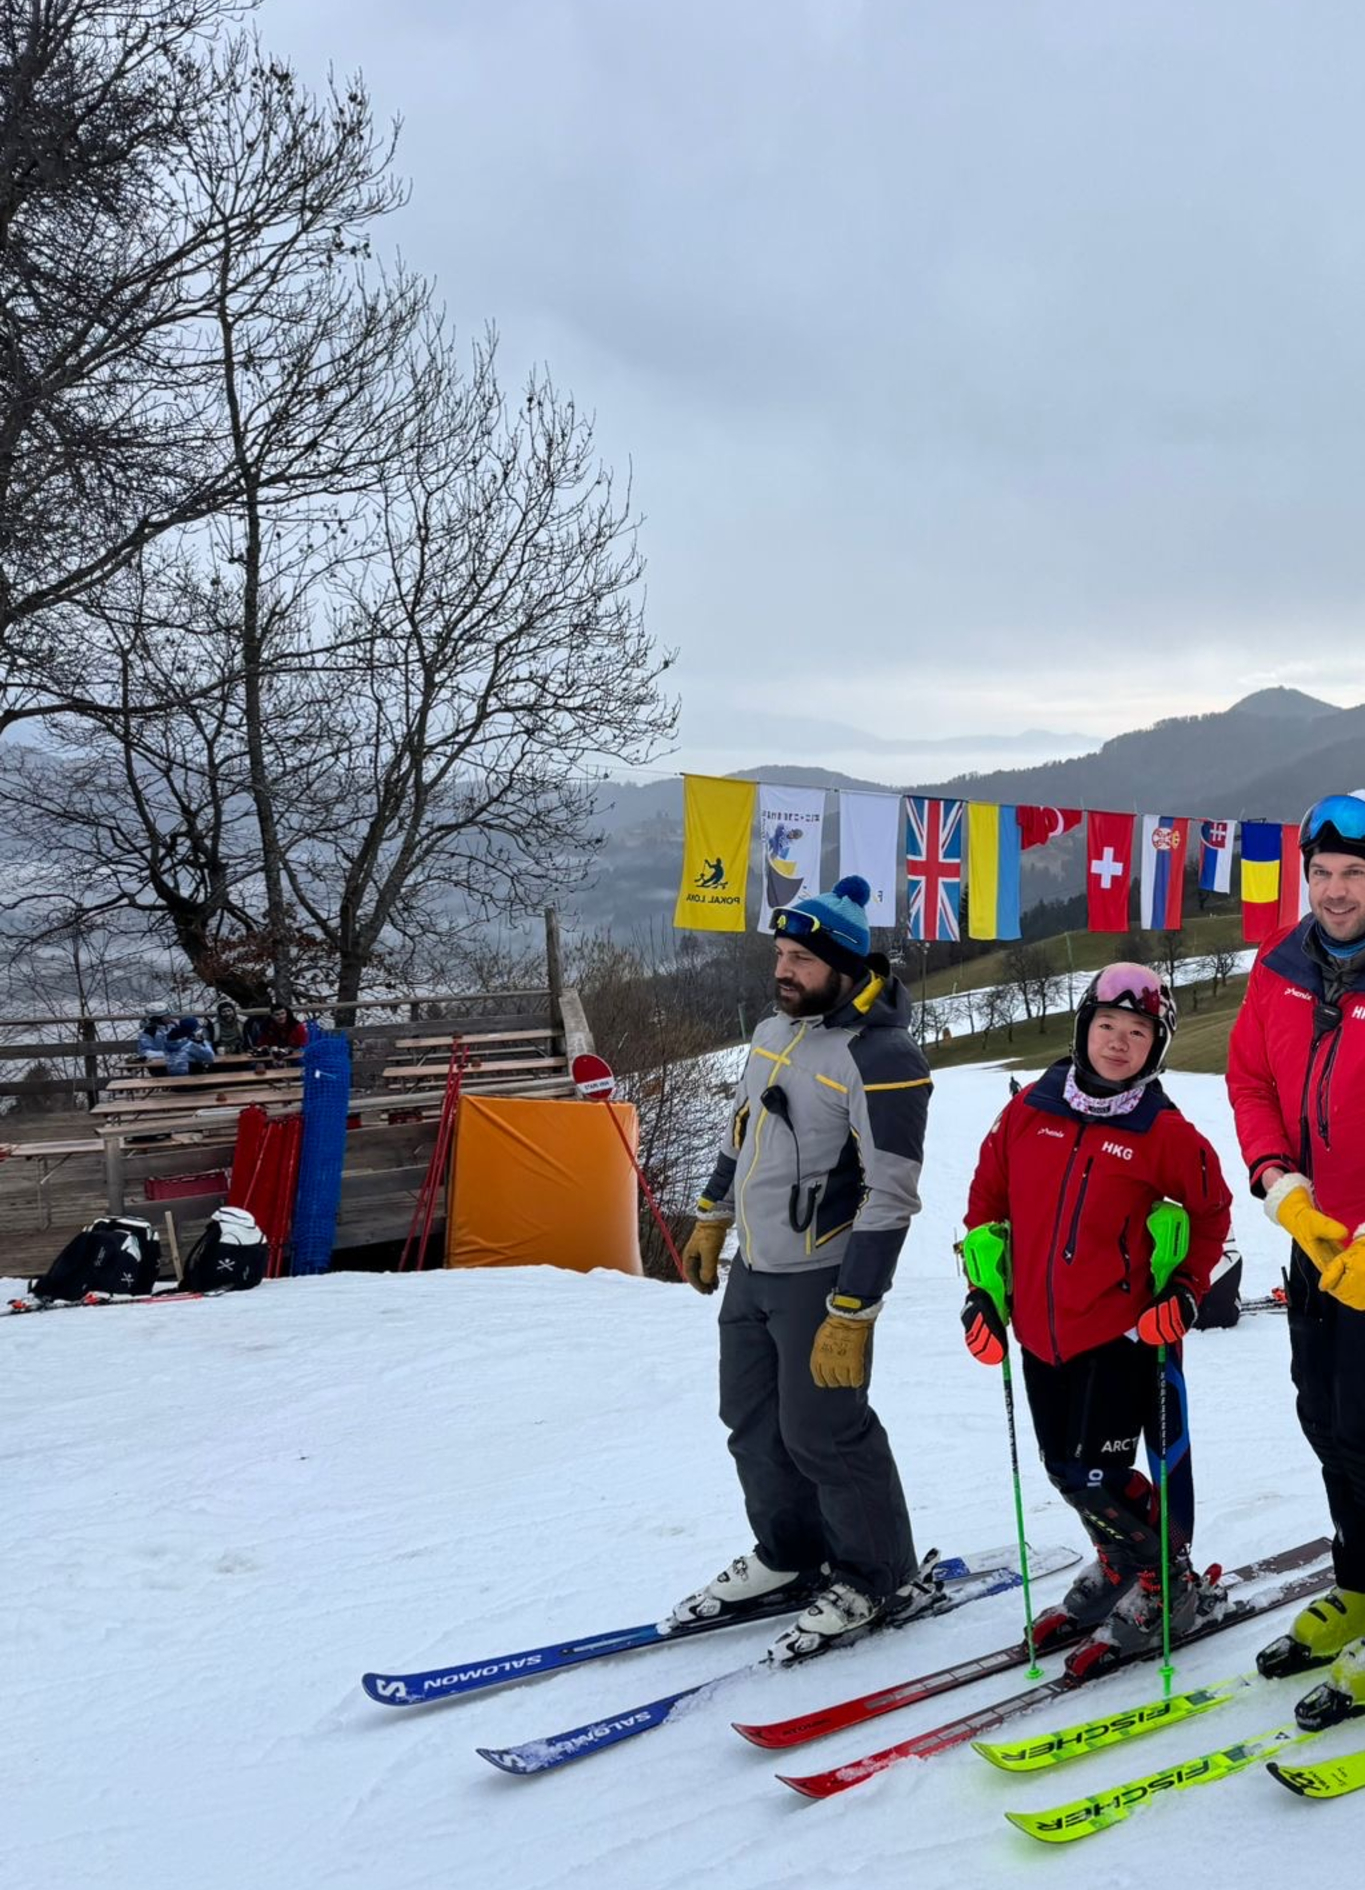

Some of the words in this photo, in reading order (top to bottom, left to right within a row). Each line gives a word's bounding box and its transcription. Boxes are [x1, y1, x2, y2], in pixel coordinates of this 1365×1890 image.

[1101, 1140, 1134, 1161] HKG
[423, 1654, 543, 1691] SALOMON
[1000, 1702, 1171, 1762] FISCHER
[1035, 1759, 1210, 1832] FISCHER
